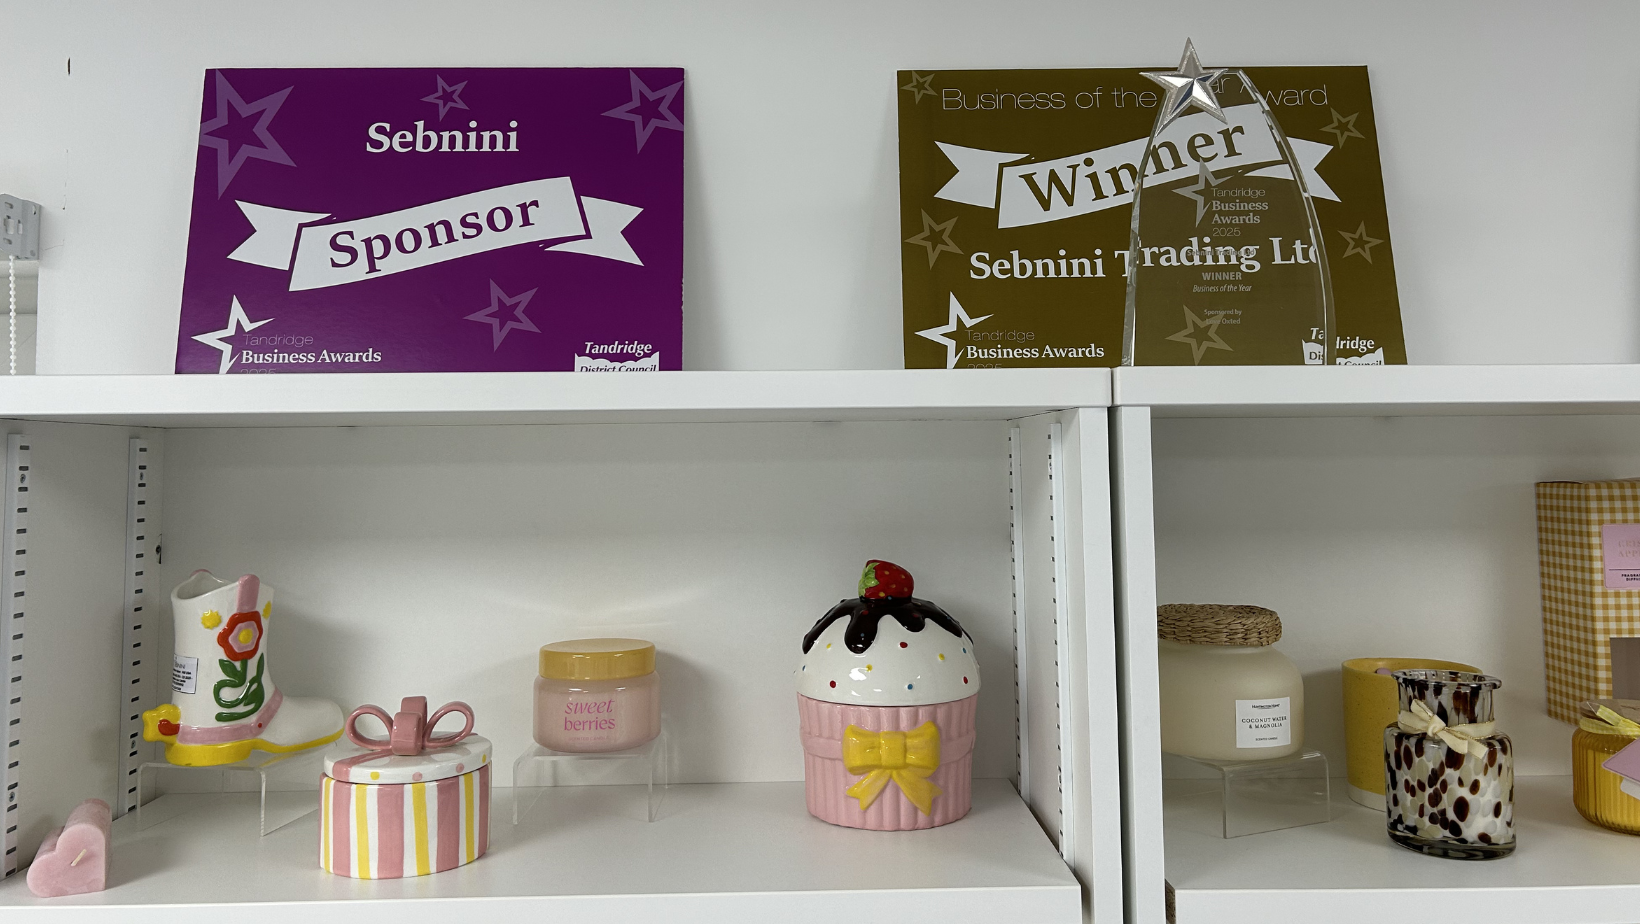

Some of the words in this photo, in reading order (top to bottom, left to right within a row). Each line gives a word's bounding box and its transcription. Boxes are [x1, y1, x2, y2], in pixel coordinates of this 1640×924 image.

[942, 88, 1066, 110] Business
[1075, 86, 1103, 109] of
[1111, 87, 1158, 108] the
[366, 120, 520, 153] Sebnini
[1018, 123, 1246, 212] Winner
[1211, 187, 1266, 198] Tandridge
[1211, 199, 1269, 211] Business
[1211, 212, 1261, 224] Awards
[328, 197, 540, 275] Sponsor
[1212, 227, 1242, 237] 2025
[969, 248, 1106, 280] Sebnini
[1114, 236, 1261, 278] Trading
[1202, 271, 1242, 280] WINNER
[1193, 284, 1219, 293] Business
[1220, 284, 1227, 292] of
[1227, 284, 1238, 292] the
[1238, 284, 1252, 292] Year
[243, 334, 314, 347] Tandridge
[965, 329, 1035, 343] Tandridge
[241, 349, 315, 363] Business
[317, 347, 382, 363] Awards
[584, 340, 653, 357] Tandridge
[966, 344, 1039, 359] Business
[1041, 343, 1105, 358] Awards
[564, 699, 615, 715] sweet
[564, 716, 616, 731] berries
